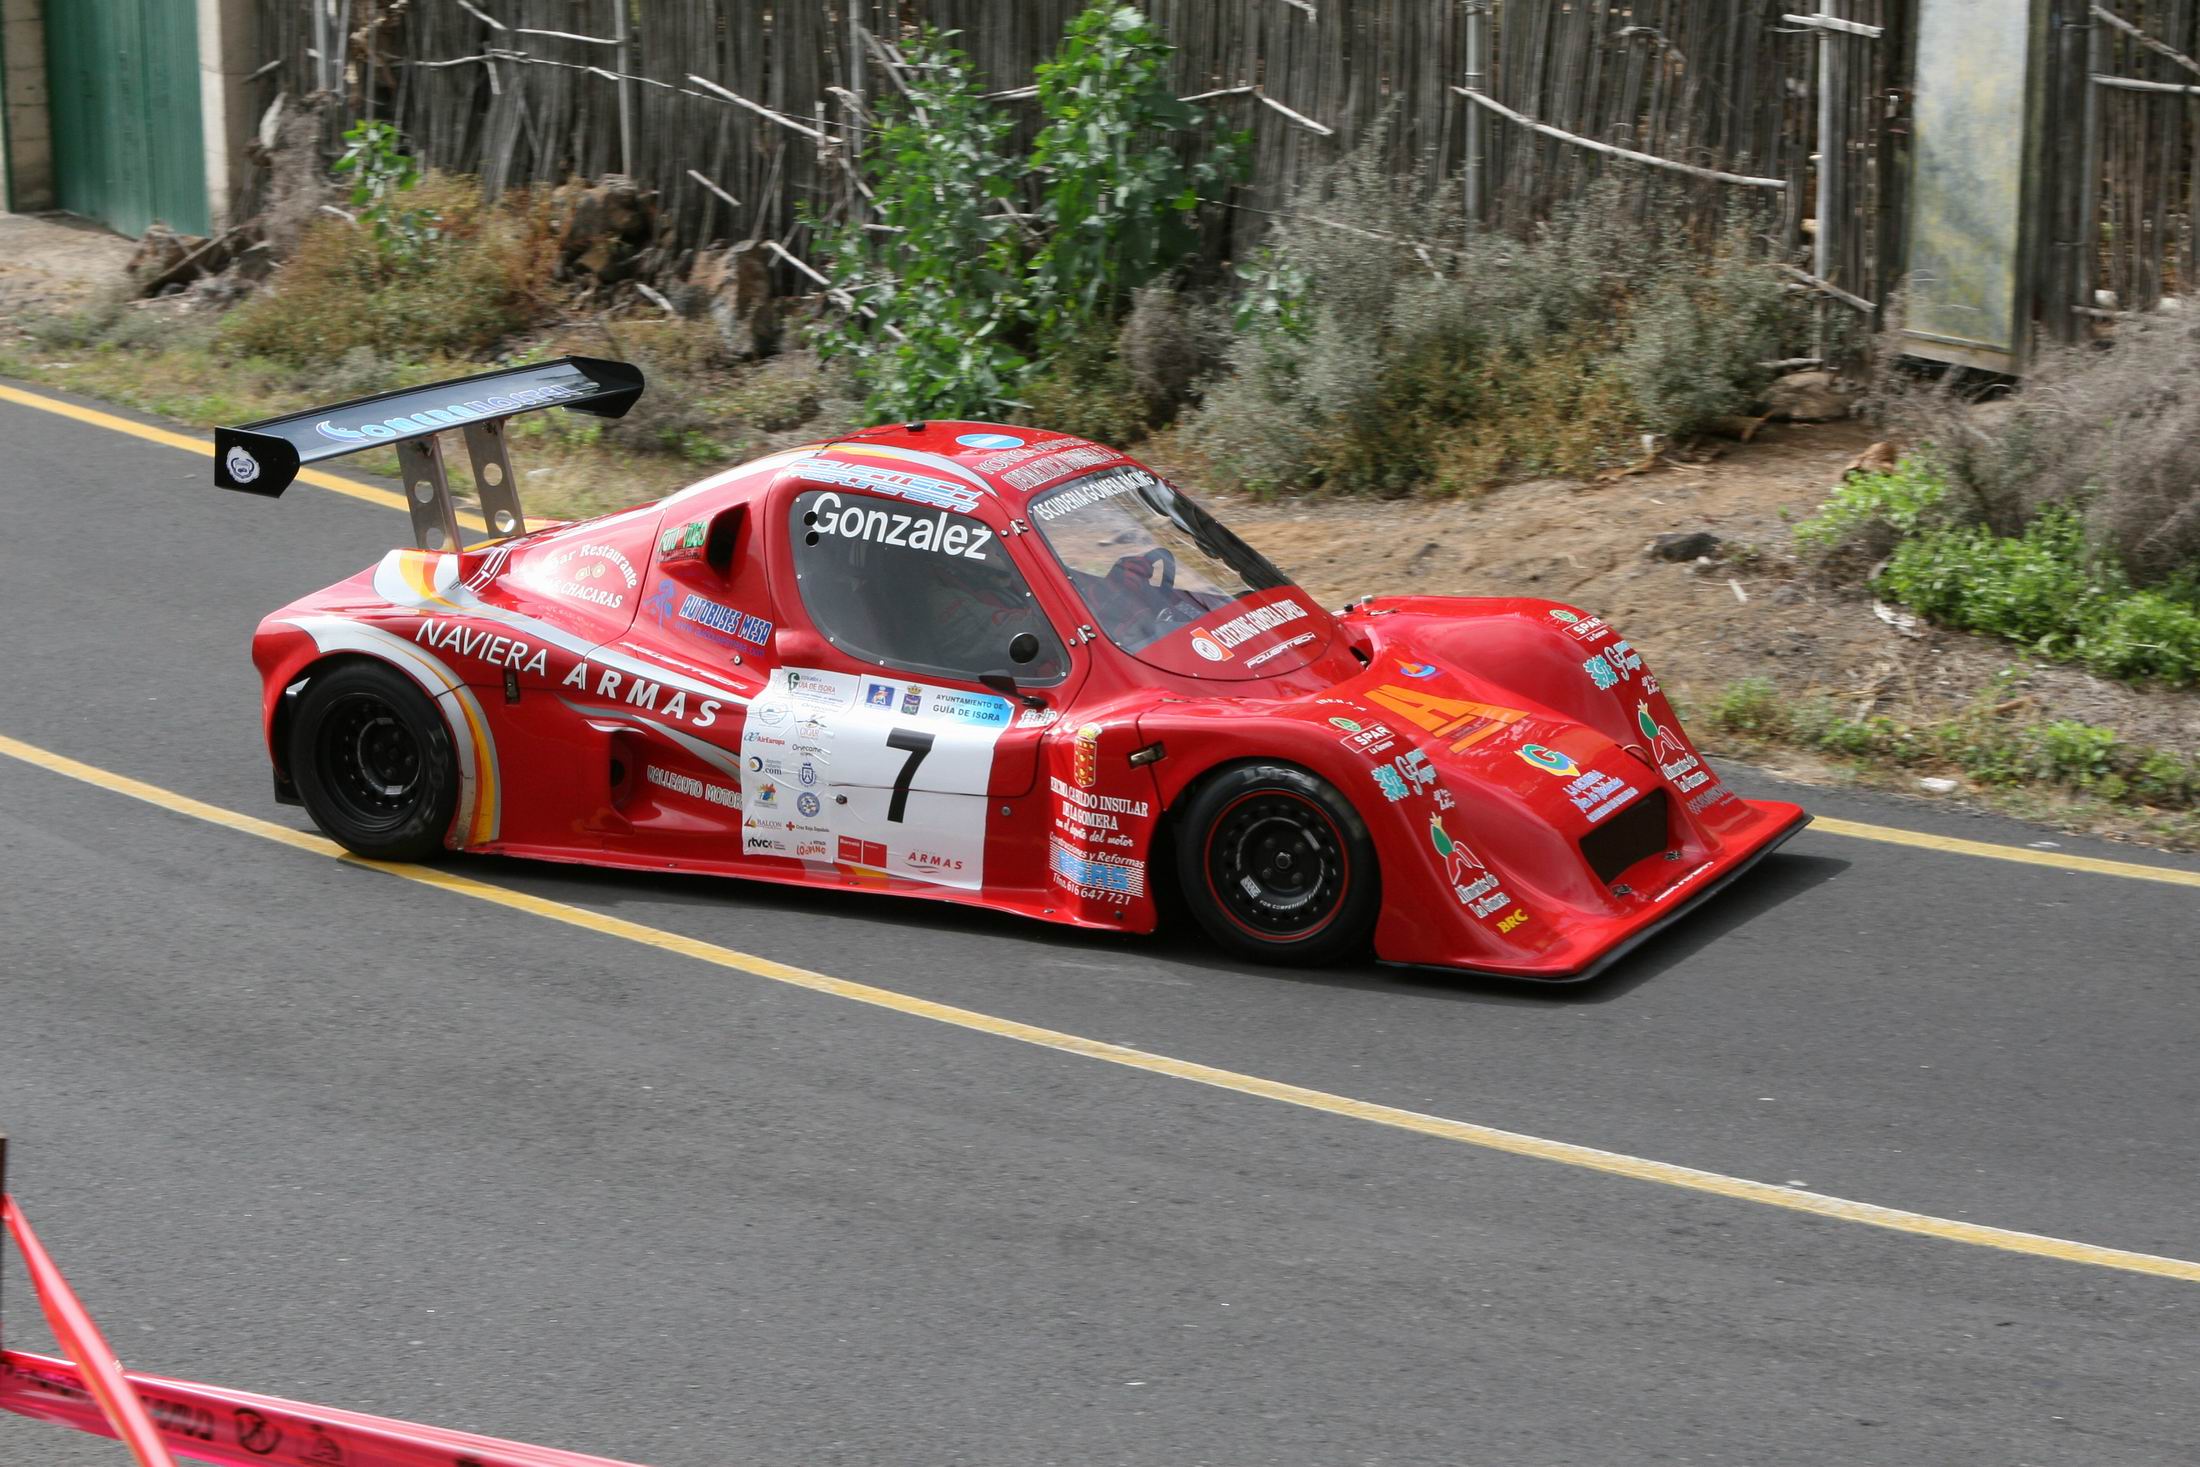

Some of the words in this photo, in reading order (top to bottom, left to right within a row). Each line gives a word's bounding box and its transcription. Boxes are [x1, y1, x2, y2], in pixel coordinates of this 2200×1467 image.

[1033, 490, 1088, 520] ESCUDERIA
[1083, 477, 1127, 502] GOMERA
[811, 492, 992, 560] Gonzalez
[579, 543, 638, 589] Restaurante
[561, 581, 622, 609] CHACARAS
[679, 594, 742, 635] AUTOBUSES
[739, 616, 772, 646] MESA
[1210, 615, 1260, 649] CATERING
[1573, 616, 1602, 634] SPAR
[415, 618, 549, 677] NAVIERA
[562, 663, 723, 728] ARMAS
[933, 704, 956, 715] GUÍA
[958, 708, 970, 717] DE
[972, 711, 1001, 722] ISORA
[936, 694, 992, 709] AYUNTAMIENTO
[993, 702, 1003, 711] DE
[1354, 725, 1390, 746] SPAR
[886, 727, 936, 823] 7
[1100, 794, 1148, 817] INSULAR
[1078, 806, 1118, 831] GOMERA
[1089, 830, 1105, 844] del
[1107, 834, 1134, 848] motor
[908, 852, 963, 870] ARMAS
[1098, 850, 1145, 869] Reformas
[1081, 886, 1105, 901] 647
[1108, 892, 1131, 906] 721
[1496, 909, 1529, 933] BRC
